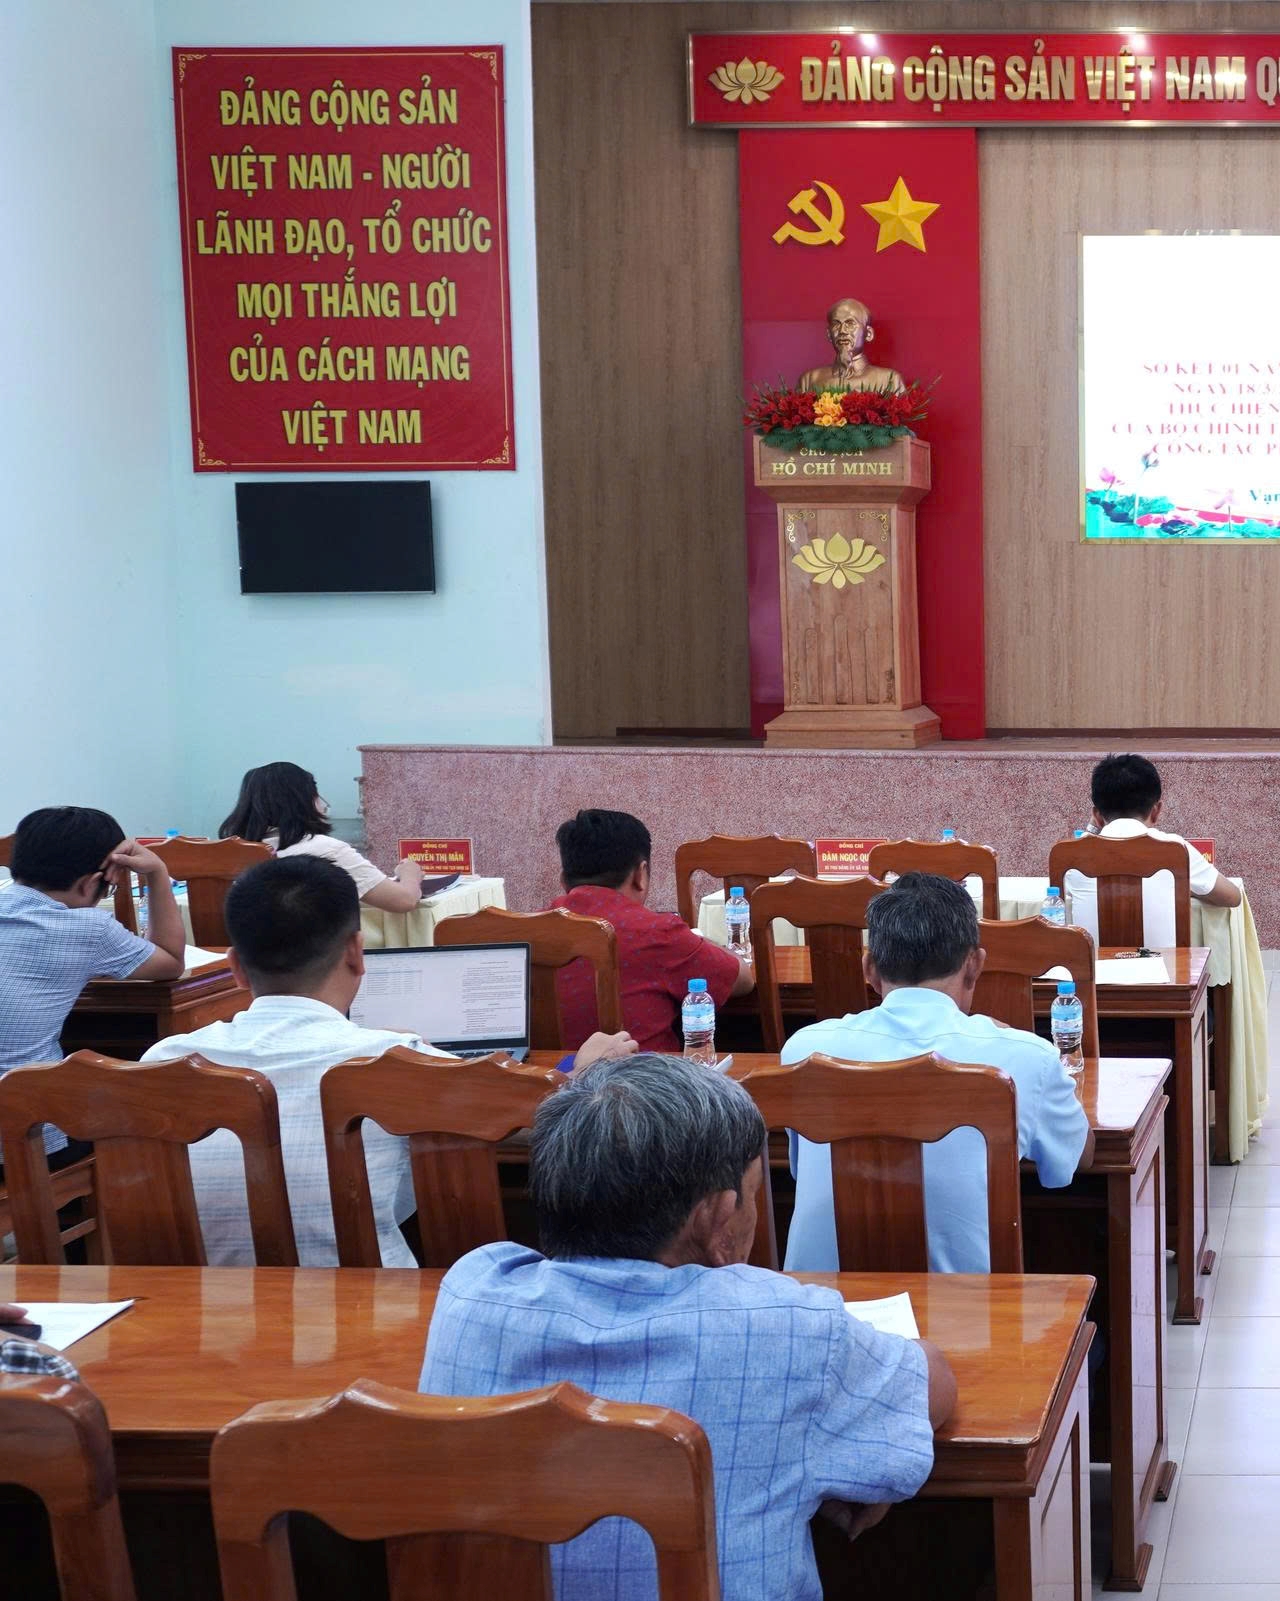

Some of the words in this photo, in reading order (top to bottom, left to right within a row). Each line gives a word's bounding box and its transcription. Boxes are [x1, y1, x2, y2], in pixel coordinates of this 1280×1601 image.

[219, 75, 301, 126] ĐẢNG
[309, 79, 390, 132] CỘNG
[398, 74, 458, 125] SẢN
[799, 38, 895, 104] ĐẢNG
[901, 42, 996, 114] CỘNG
[1002, 38, 1076, 104] SẢN
[1082, 43, 1156, 114] VIỆT
[1165, 54, 1246, 104] NAM
[210, 145, 277, 198] VIỆT
[288, 154, 353, 190] NAM
[382, 143, 471, 190] NGƯỜI
[196, 210, 274, 254] LÃNH
[284, 218, 355, 262] ĐẠO,
[362, 199, 402, 254] TỔ
[412, 207, 492, 254] CHỨC
[237, 283, 293, 326] MỌI
[300, 267, 401, 318] THẮNG
[409, 276, 457, 325] LỢI
[229, 333, 289, 382] CỦA
[297, 337, 376, 382] CÁCH
[385, 344, 471, 388] MẠNG
[282, 400, 348, 452] VIỆT
[358, 409, 422, 444] NAM
[772, 457, 798, 476] HỒ
[803, 458, 837, 476] CHÍ
[842, 461, 892, 476] MINH
